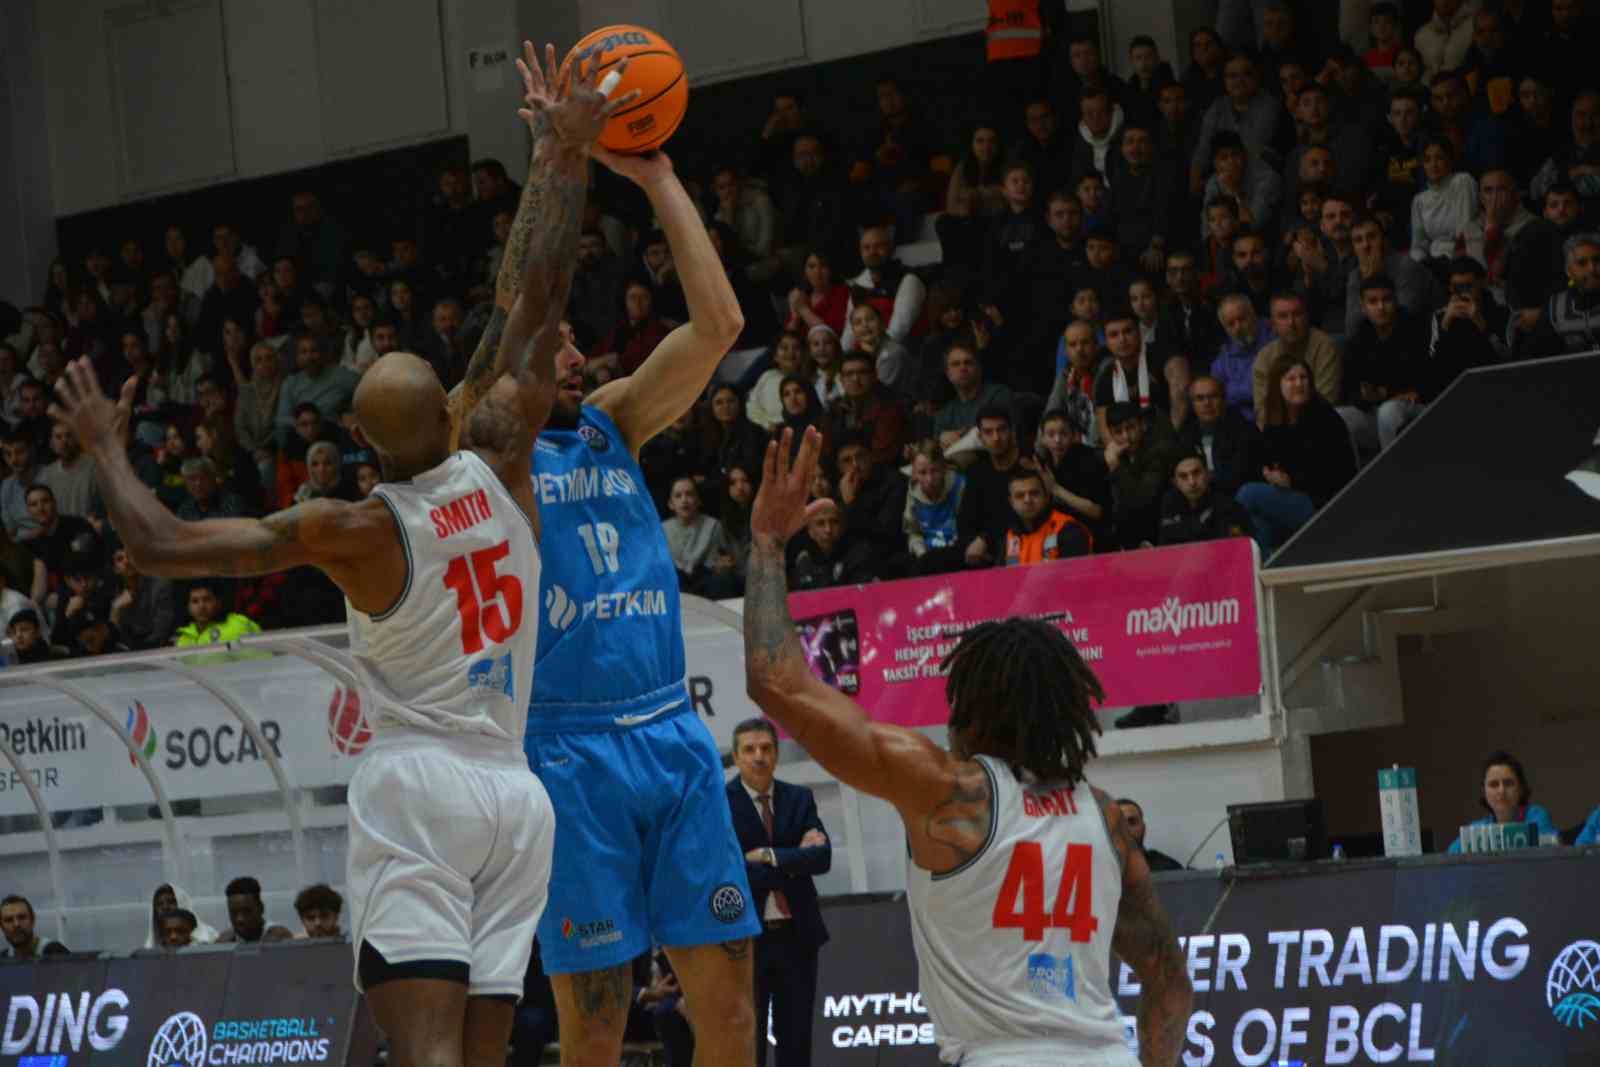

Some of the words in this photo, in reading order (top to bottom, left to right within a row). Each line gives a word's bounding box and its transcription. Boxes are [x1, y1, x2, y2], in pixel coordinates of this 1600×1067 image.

[430, 488, 492, 539] SMITH
[577, 522, 619, 576] 19
[442, 539, 523, 655] 15
[165, 721, 283, 770] SOCAR
[992, 841, 1098, 942] 44
[1268, 917, 1530, 989] TRADING
[208, 1037, 329, 1066] CHAMPIONS
[213, 1016, 320, 1041] BASKETBALL
[831, 1022, 935, 1048] CARDS
[1232, 1007, 1311, 1067] OF
[1325, 1002, 1435, 1065] BCL
